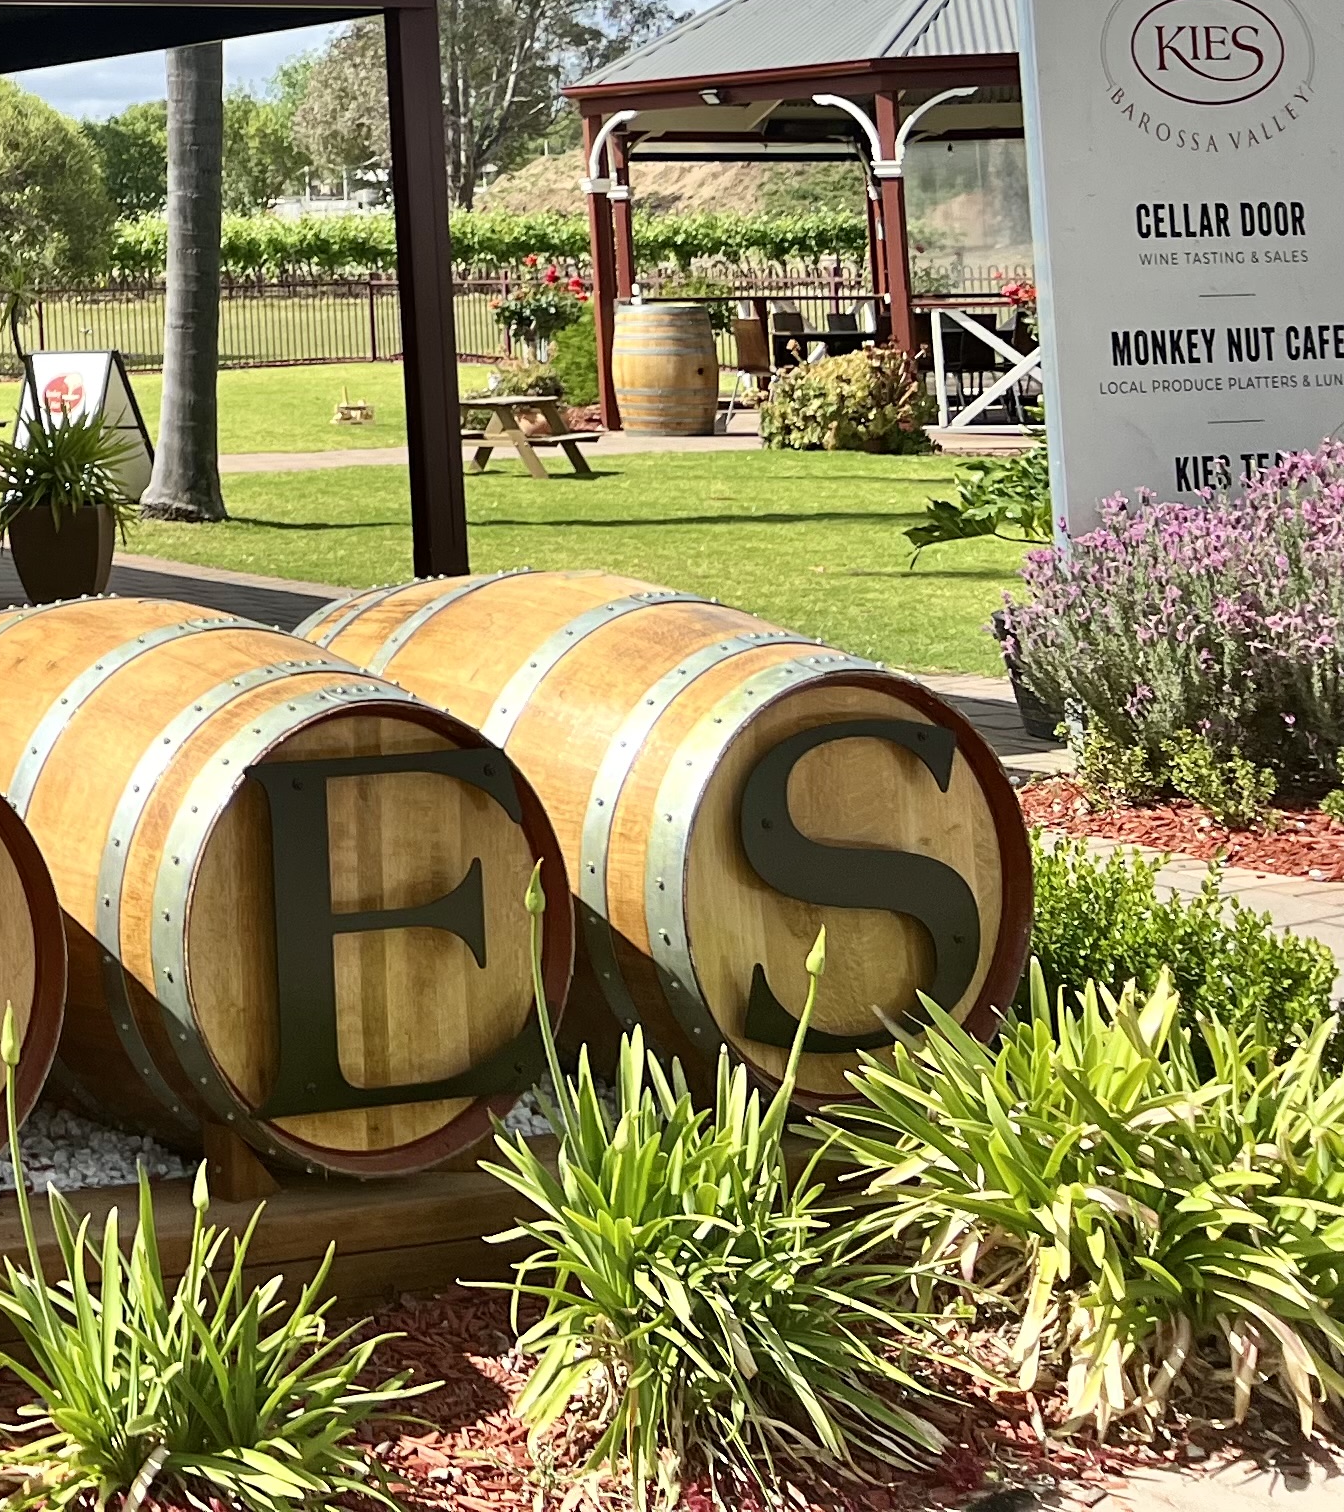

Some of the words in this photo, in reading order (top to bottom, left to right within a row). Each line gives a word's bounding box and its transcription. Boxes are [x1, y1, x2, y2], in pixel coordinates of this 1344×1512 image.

[1155, 25, 1264, 82] KIES
[1110, 87, 1219, 153] BAROSSA
[1228, 85, 1309, 150] VALLEY
[1136, 203, 1231, 238] CELLAR
[1240, 201, 1306, 237] DOOR
[1139, 253, 1179, 266] WINE
[1184, 251, 1245, 265] TASTING
[1250, 251, 1259, 264] &
[1264, 250, 1309, 263] SALES
[1111, 328, 1216, 367] MONKEY
[1227, 326, 1275, 363] NUT
[1285, 324, 1344, 361] CAFE
[1099, 381, 1148, 395] LOCAL
[1152, 378, 1223, 393] PRODUCE
[1228, 375, 1298, 390] PLATTERS
[1303, 374, 1311, 387] &
[1175, 455, 1232, 492] KIES
